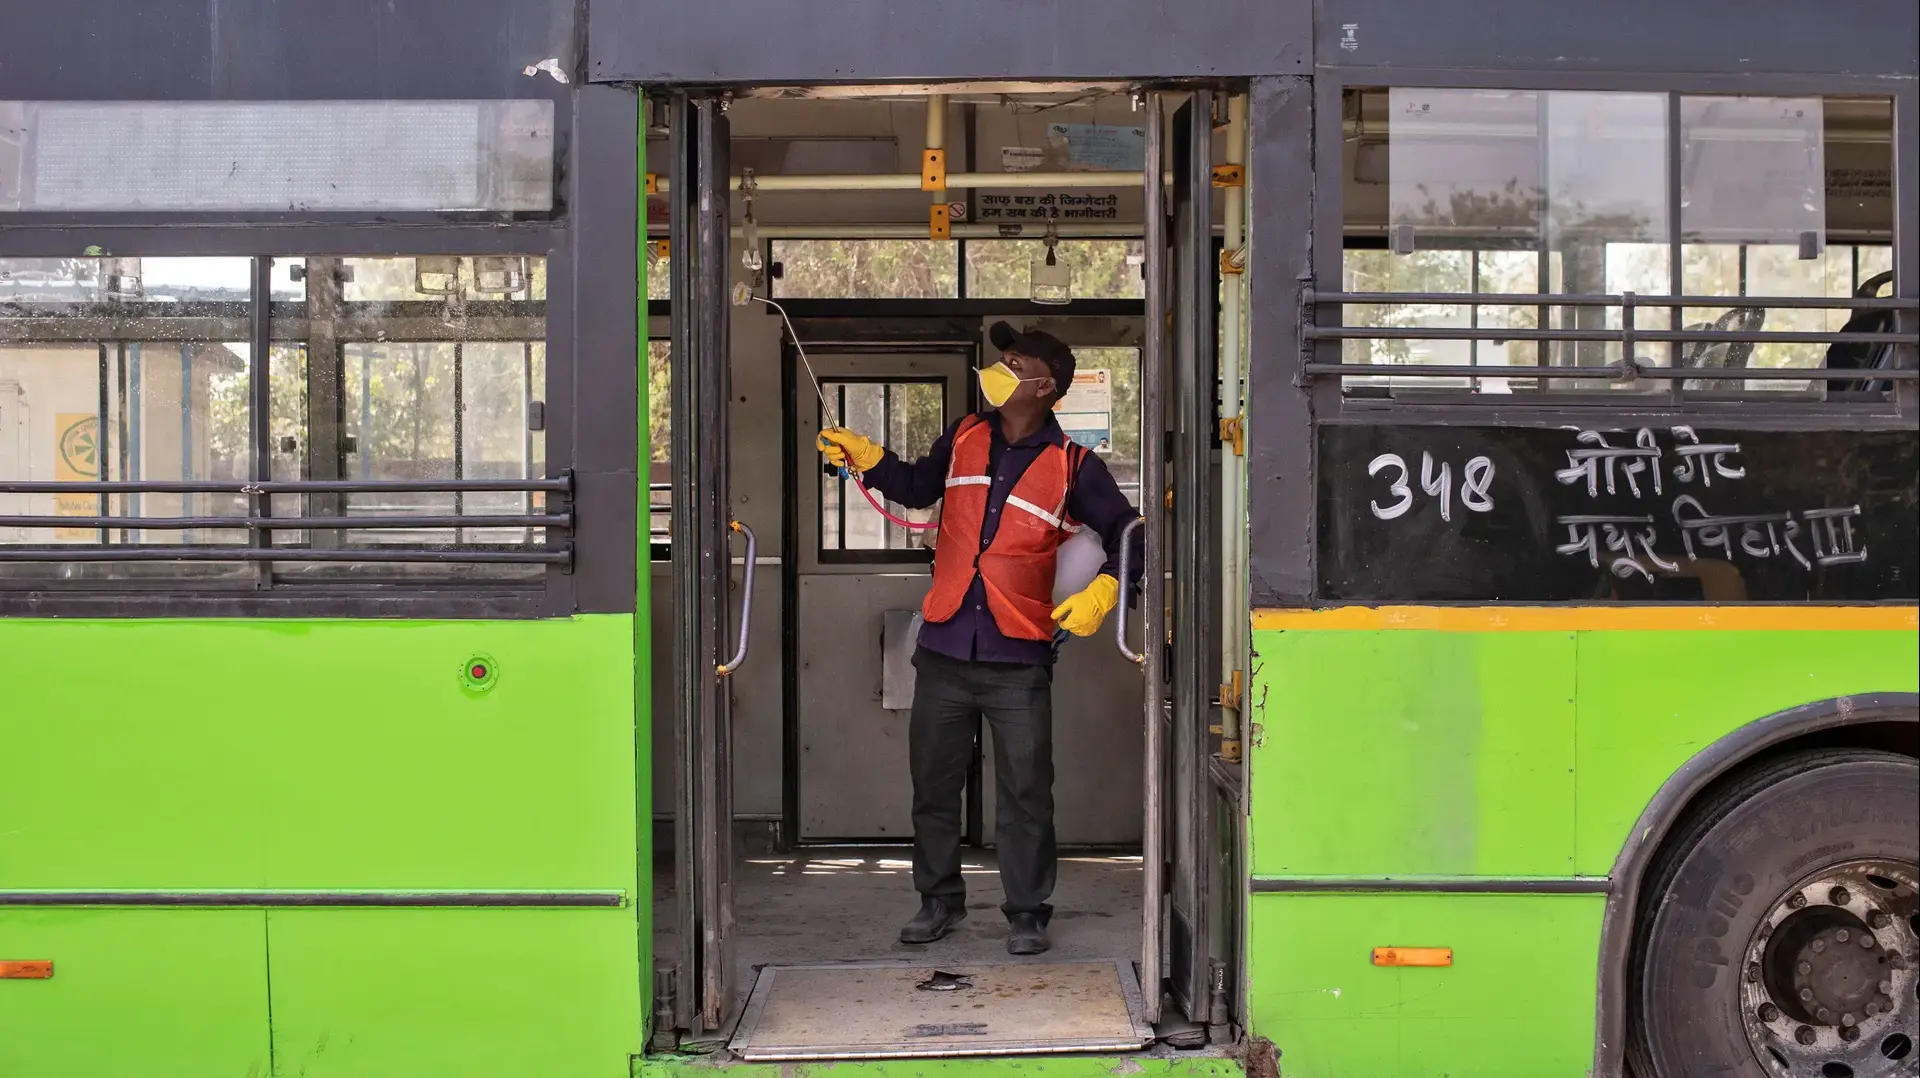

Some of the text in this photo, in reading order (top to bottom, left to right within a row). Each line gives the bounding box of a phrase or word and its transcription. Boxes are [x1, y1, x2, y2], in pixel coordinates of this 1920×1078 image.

[981, 206, 1118, 219] हम सब की है भागीदारी
[1014, 196, 1036, 206] बस
[1039, 194, 1056, 206] की
[1059, 194, 1118, 206] जिम्मेदारी
[1368, 451, 1496, 522] 348
[1555, 425, 1746, 498] मोरी गेट
[1556, 513, 1679, 584] मयूर
[1672, 494, 1812, 571] विहार
